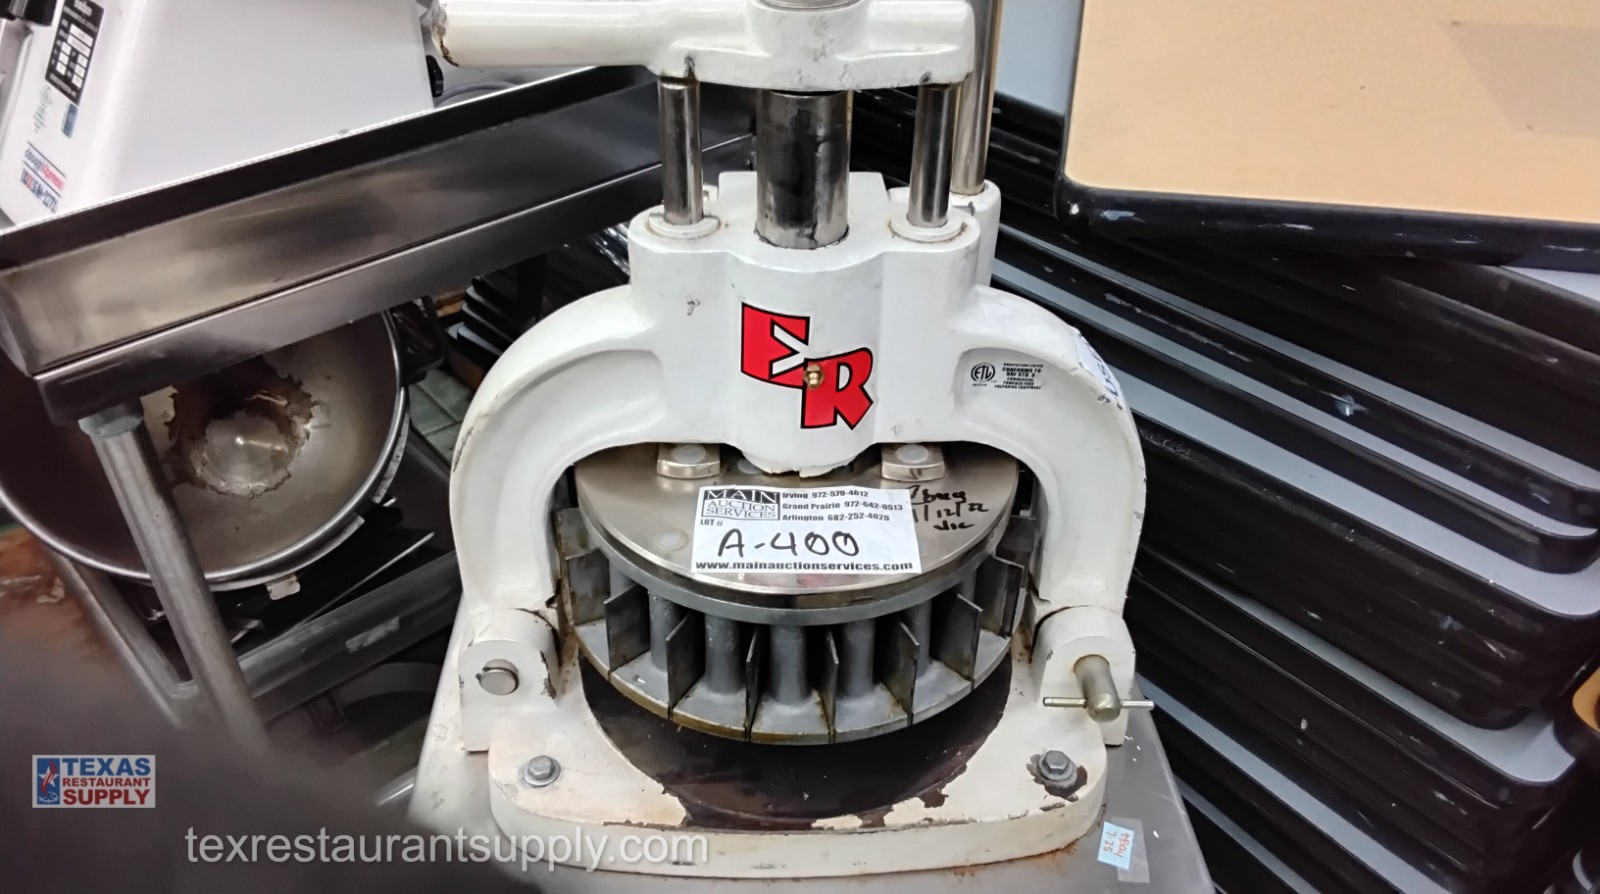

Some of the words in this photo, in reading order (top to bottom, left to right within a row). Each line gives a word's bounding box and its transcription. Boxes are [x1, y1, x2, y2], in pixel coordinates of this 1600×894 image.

[707, 490, 777, 504] MAIN
[707, 500, 776, 512] AUCTION
[706, 508, 776, 518] SERVICES
[718, 528, 860, 558] A-400
[696, 561, 913, 571] www.mainauctionservices.com
